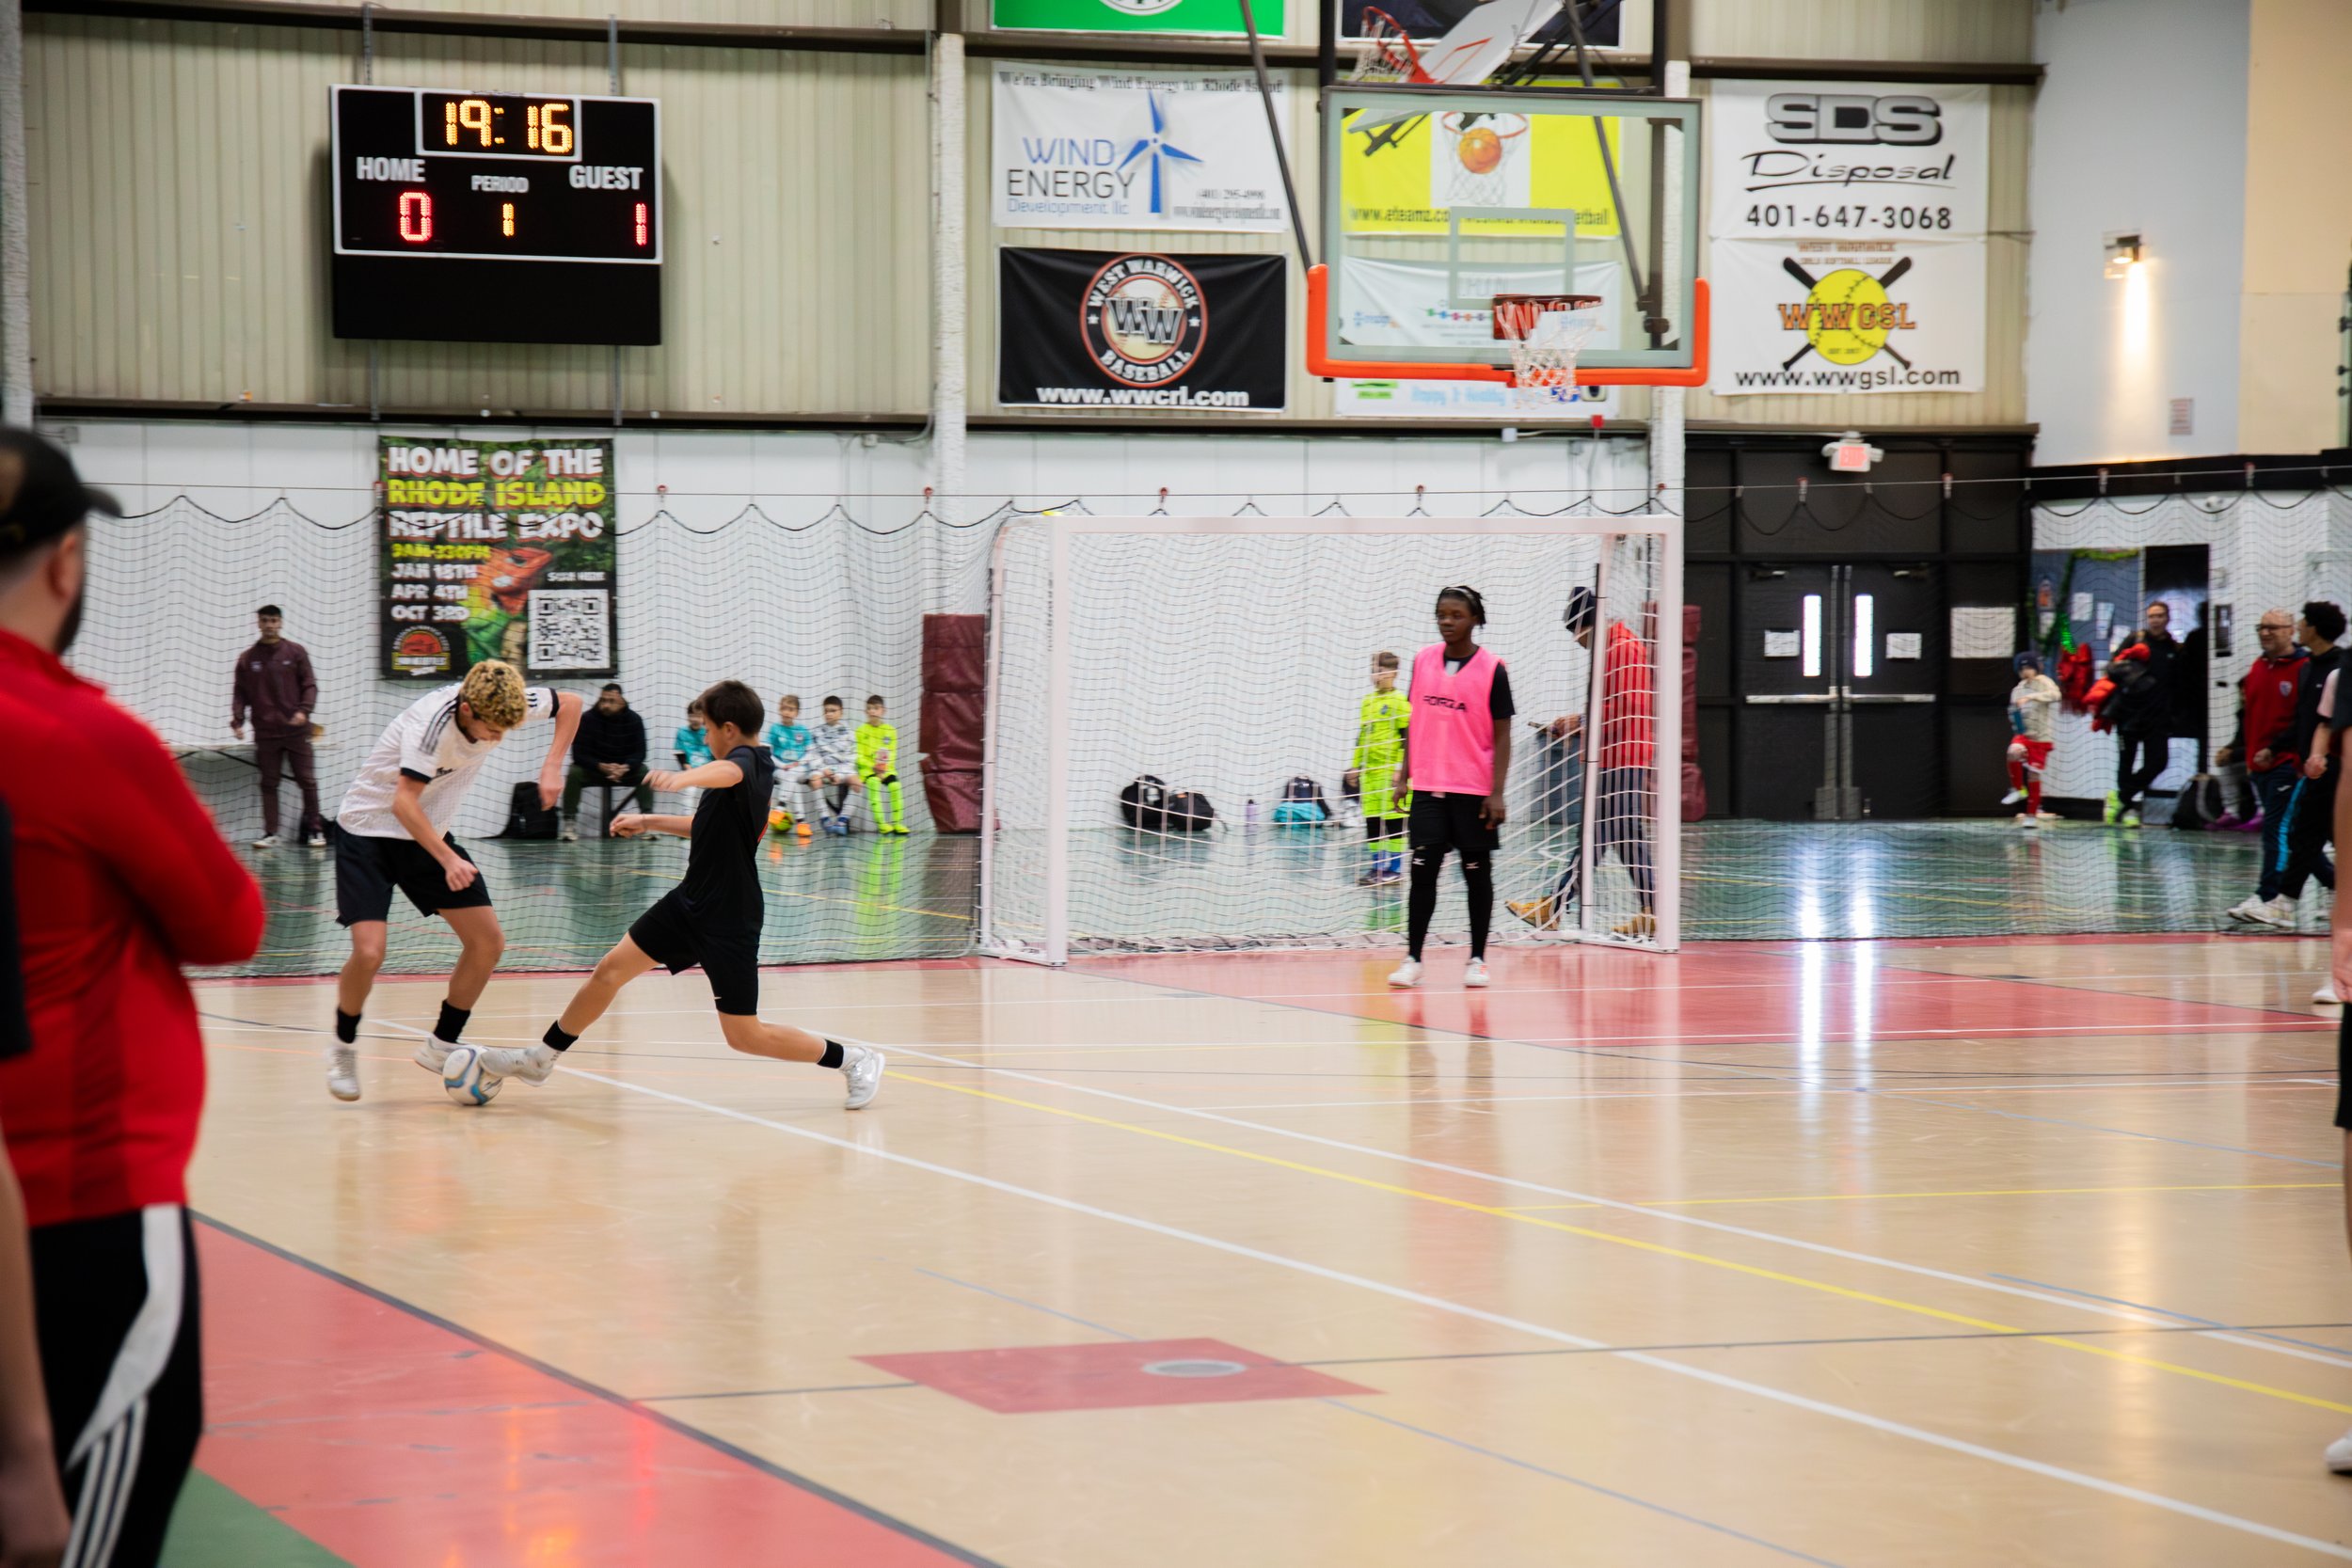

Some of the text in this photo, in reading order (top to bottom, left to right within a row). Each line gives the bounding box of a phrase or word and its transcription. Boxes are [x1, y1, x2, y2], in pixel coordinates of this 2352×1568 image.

[1040, 72, 1095, 91] Bringing
[1765, 92, 1943, 146] SDS
[1023, 137, 1116, 166] WIND
[356, 156, 426, 182] HOME
[568, 165, 644, 190] GUEST
[1740, 150, 1956, 187] Disposal
[470, 175, 530, 194] PERIOD
[1007, 168, 1136, 199] ENERGY
[399, 191, 433, 243] 0
[502, 202, 515, 237] 1
[1007, 198, 1130, 216] Development llc
[1746, 204, 1952, 230] 401-647-3068
[635, 202, 647, 246] 1
[1088, 259, 1200, 309] WEST WARWICK
[1100, 349, 1193, 382] BASEBALL
[1735, 366, 1962, 390] www.wwgsl.com
[388, 446, 603, 477] HOME OF THE
[388, 479, 607, 507] RHODE ISLAND
[388, 509, 605, 540] REPTILE EXPO
[390, 562, 431, 579] JAN
[390, 583, 429, 600] APR
[390, 604, 469, 622] OCT 3RD
[1422, 695, 1468, 712] FORZA
